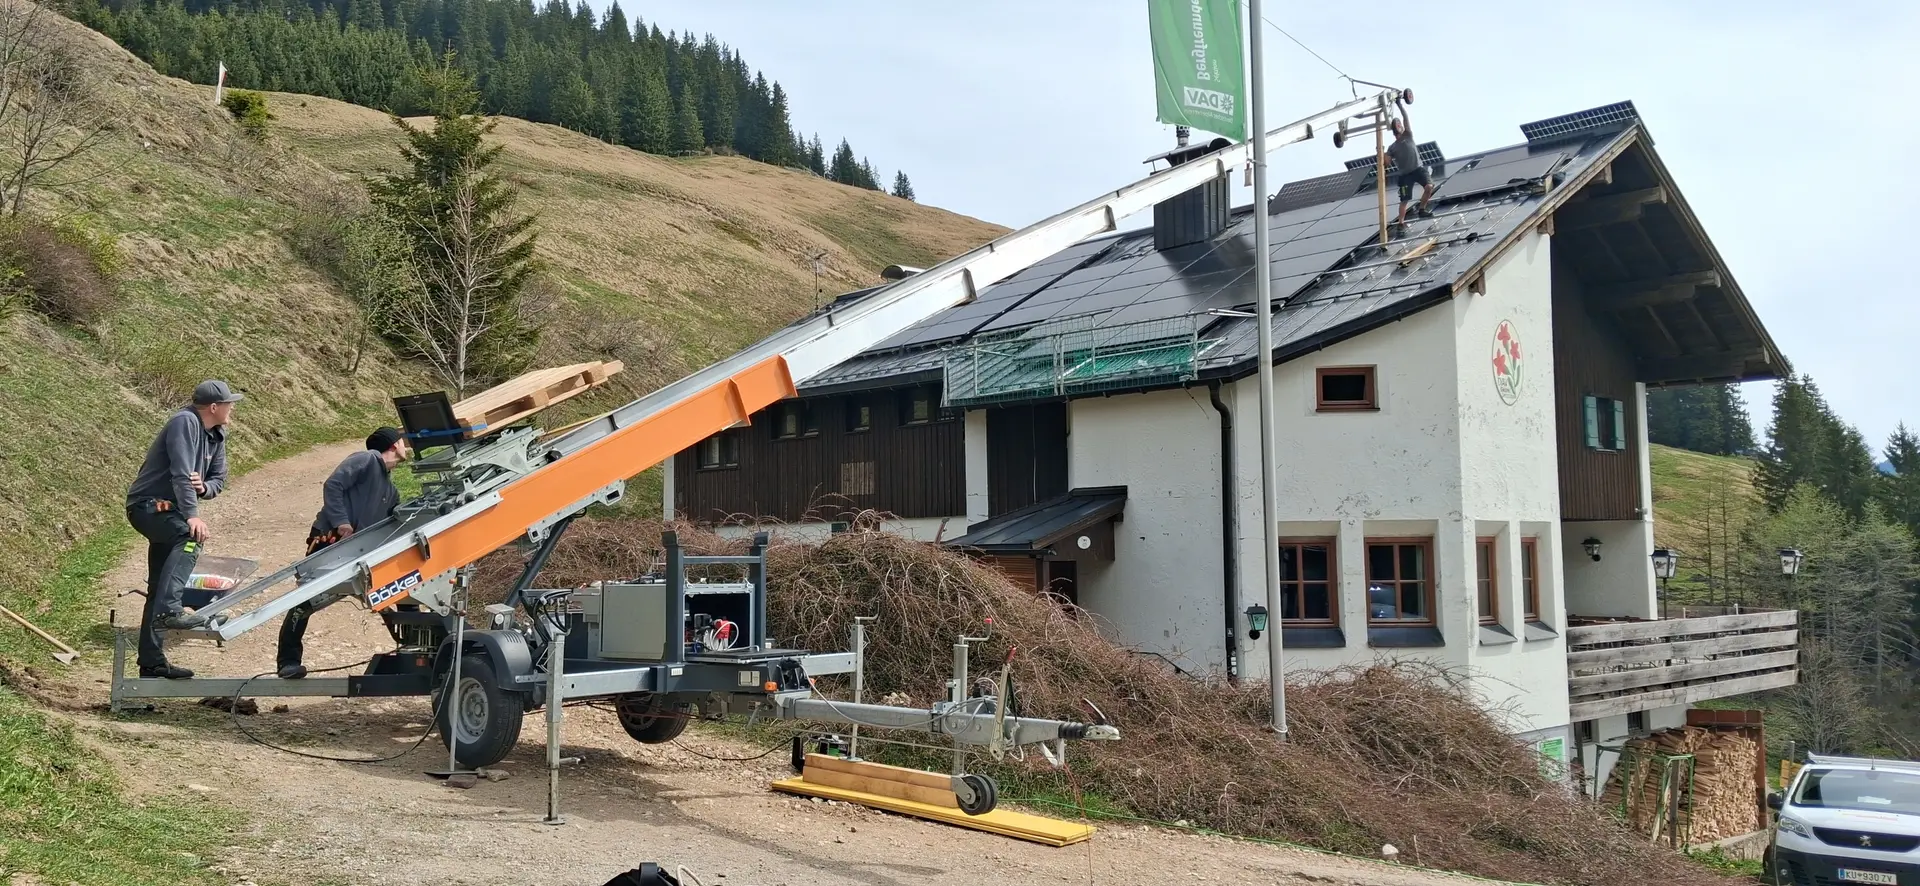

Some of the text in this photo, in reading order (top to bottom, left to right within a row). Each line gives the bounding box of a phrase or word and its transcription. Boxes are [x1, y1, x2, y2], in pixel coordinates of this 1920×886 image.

[368, 572, 421, 606] Böcker
[1846, 871, 1857, 879] KU
[1863, 873, 1880, 882] 930
